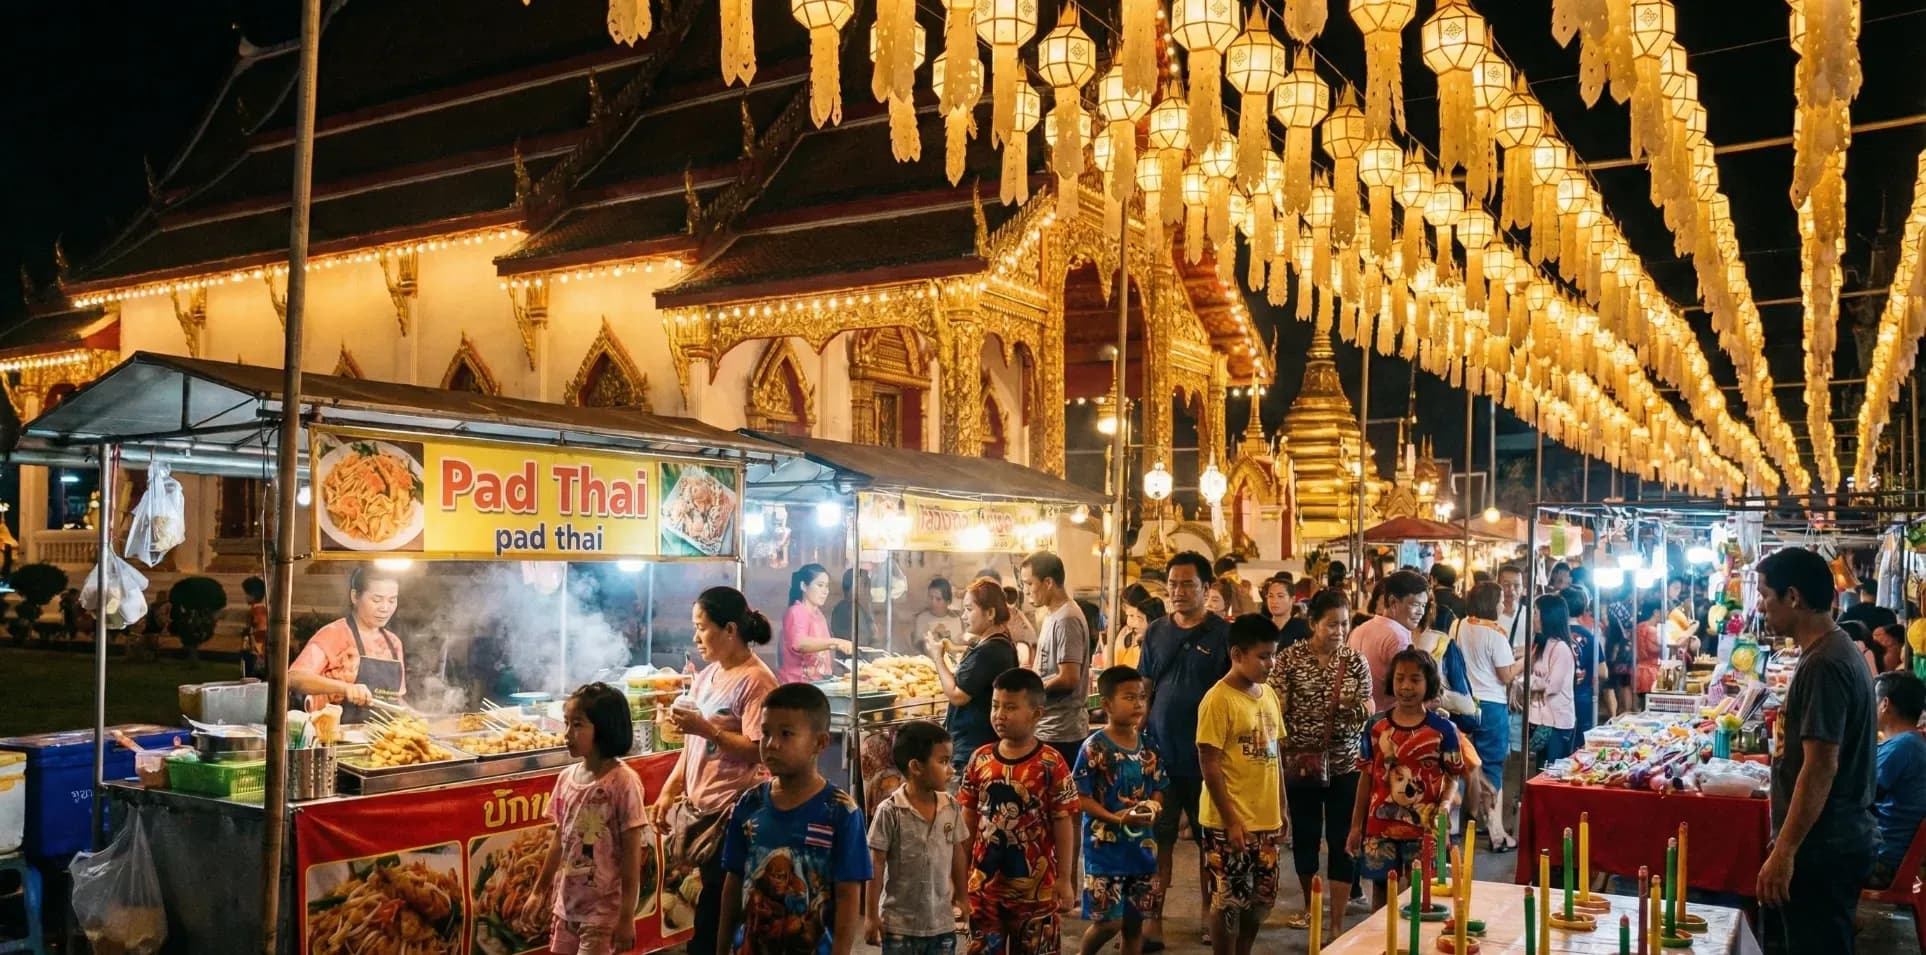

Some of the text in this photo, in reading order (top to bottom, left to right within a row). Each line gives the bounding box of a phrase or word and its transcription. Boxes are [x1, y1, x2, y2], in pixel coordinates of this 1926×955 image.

[441, 458, 648, 519] Pad Thai
[496, 522, 603, 556] pad thai
